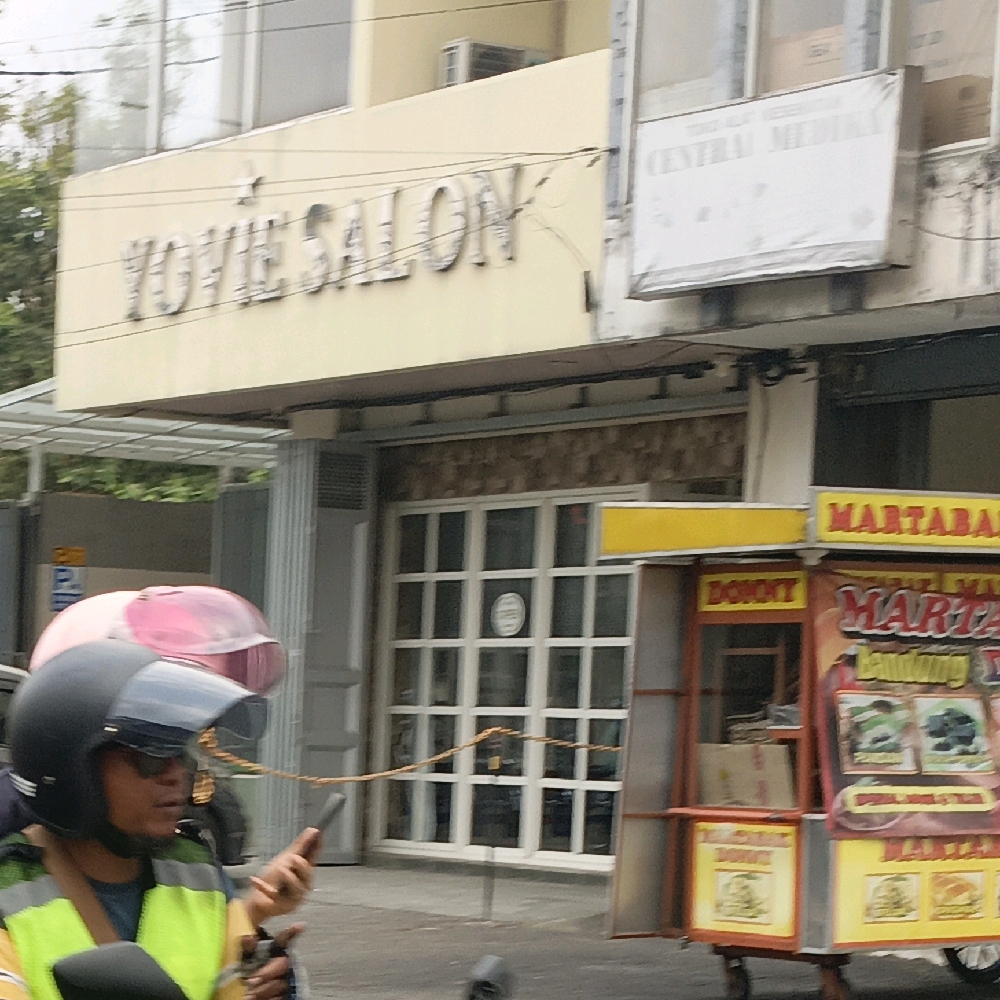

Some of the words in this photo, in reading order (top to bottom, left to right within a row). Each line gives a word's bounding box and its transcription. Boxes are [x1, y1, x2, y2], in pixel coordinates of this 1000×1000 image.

[120, 212, 288, 322] YOVIE
[301, 163, 526, 295] SALON
[827, 502, 1000, 538] MARTABA
